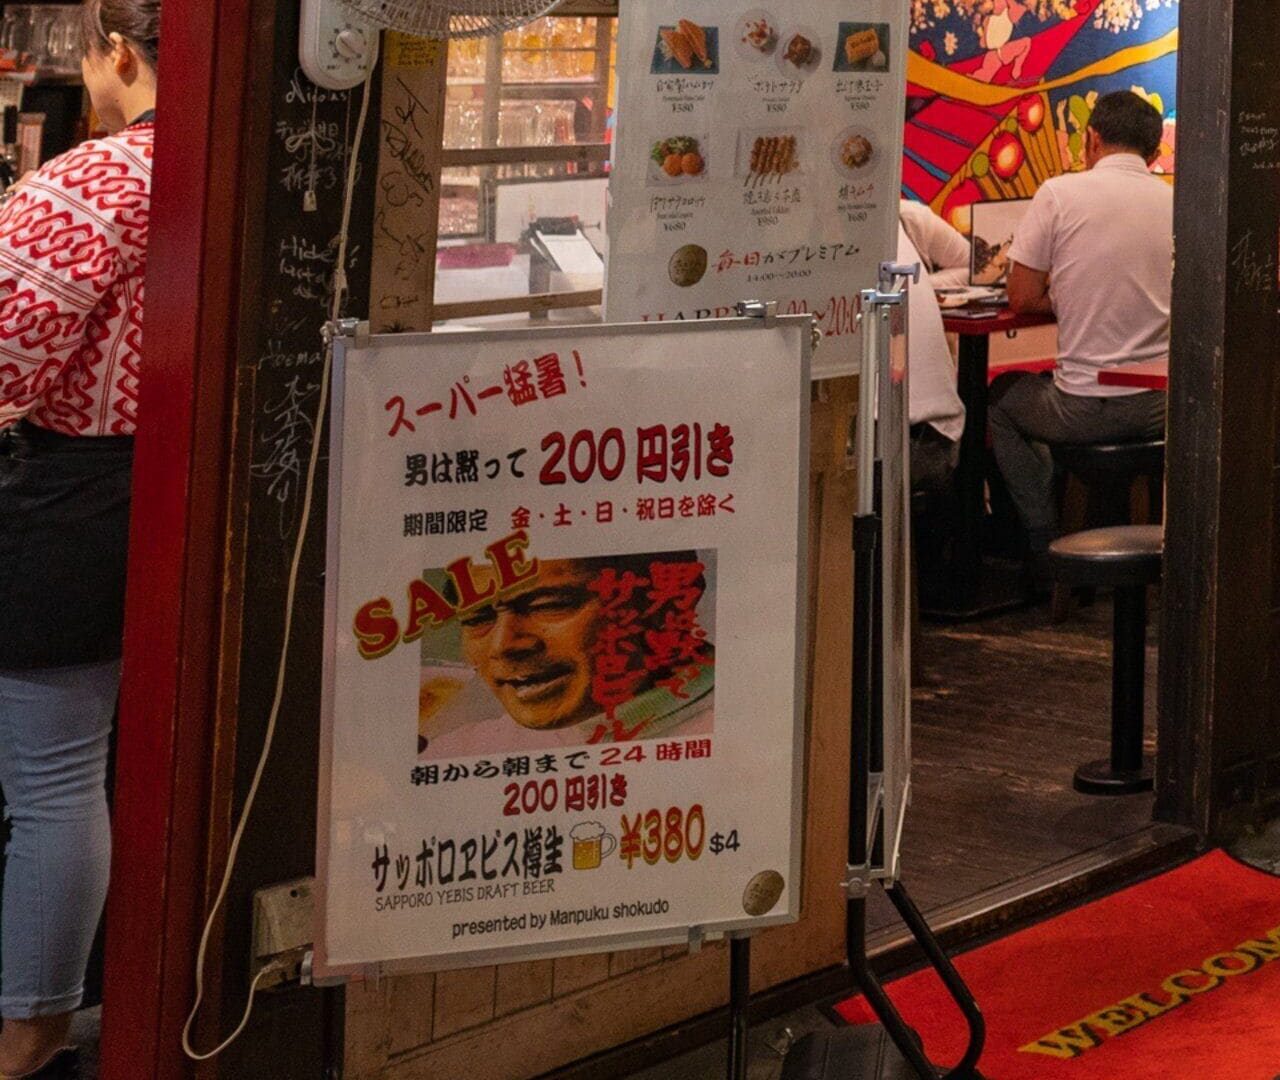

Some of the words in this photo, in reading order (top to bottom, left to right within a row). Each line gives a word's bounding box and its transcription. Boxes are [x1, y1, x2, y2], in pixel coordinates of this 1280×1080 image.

[711, 244, 860, 274] 毎日がプレミアム
[404, 448, 528, 487] 男は黙って
[402, 508, 489, 538] 期間限定
[352, 530, 540, 661] SALE
[410, 750, 591, 786] 朝から朝まで
[618, 803, 706, 871] ¥380
[709, 829, 741, 857] $4
[375, 892, 434, 912] SAPPORO
[436, 887, 475, 906] YEBIS
[476, 882, 521, 901] DRAFT
[522, 878, 556, 896] BEER
[451, 914, 527, 940] presented
[529, 910, 547, 931] by
[549, 905, 609, 928] Manpuku
[612, 899, 670, 919] shokudo
